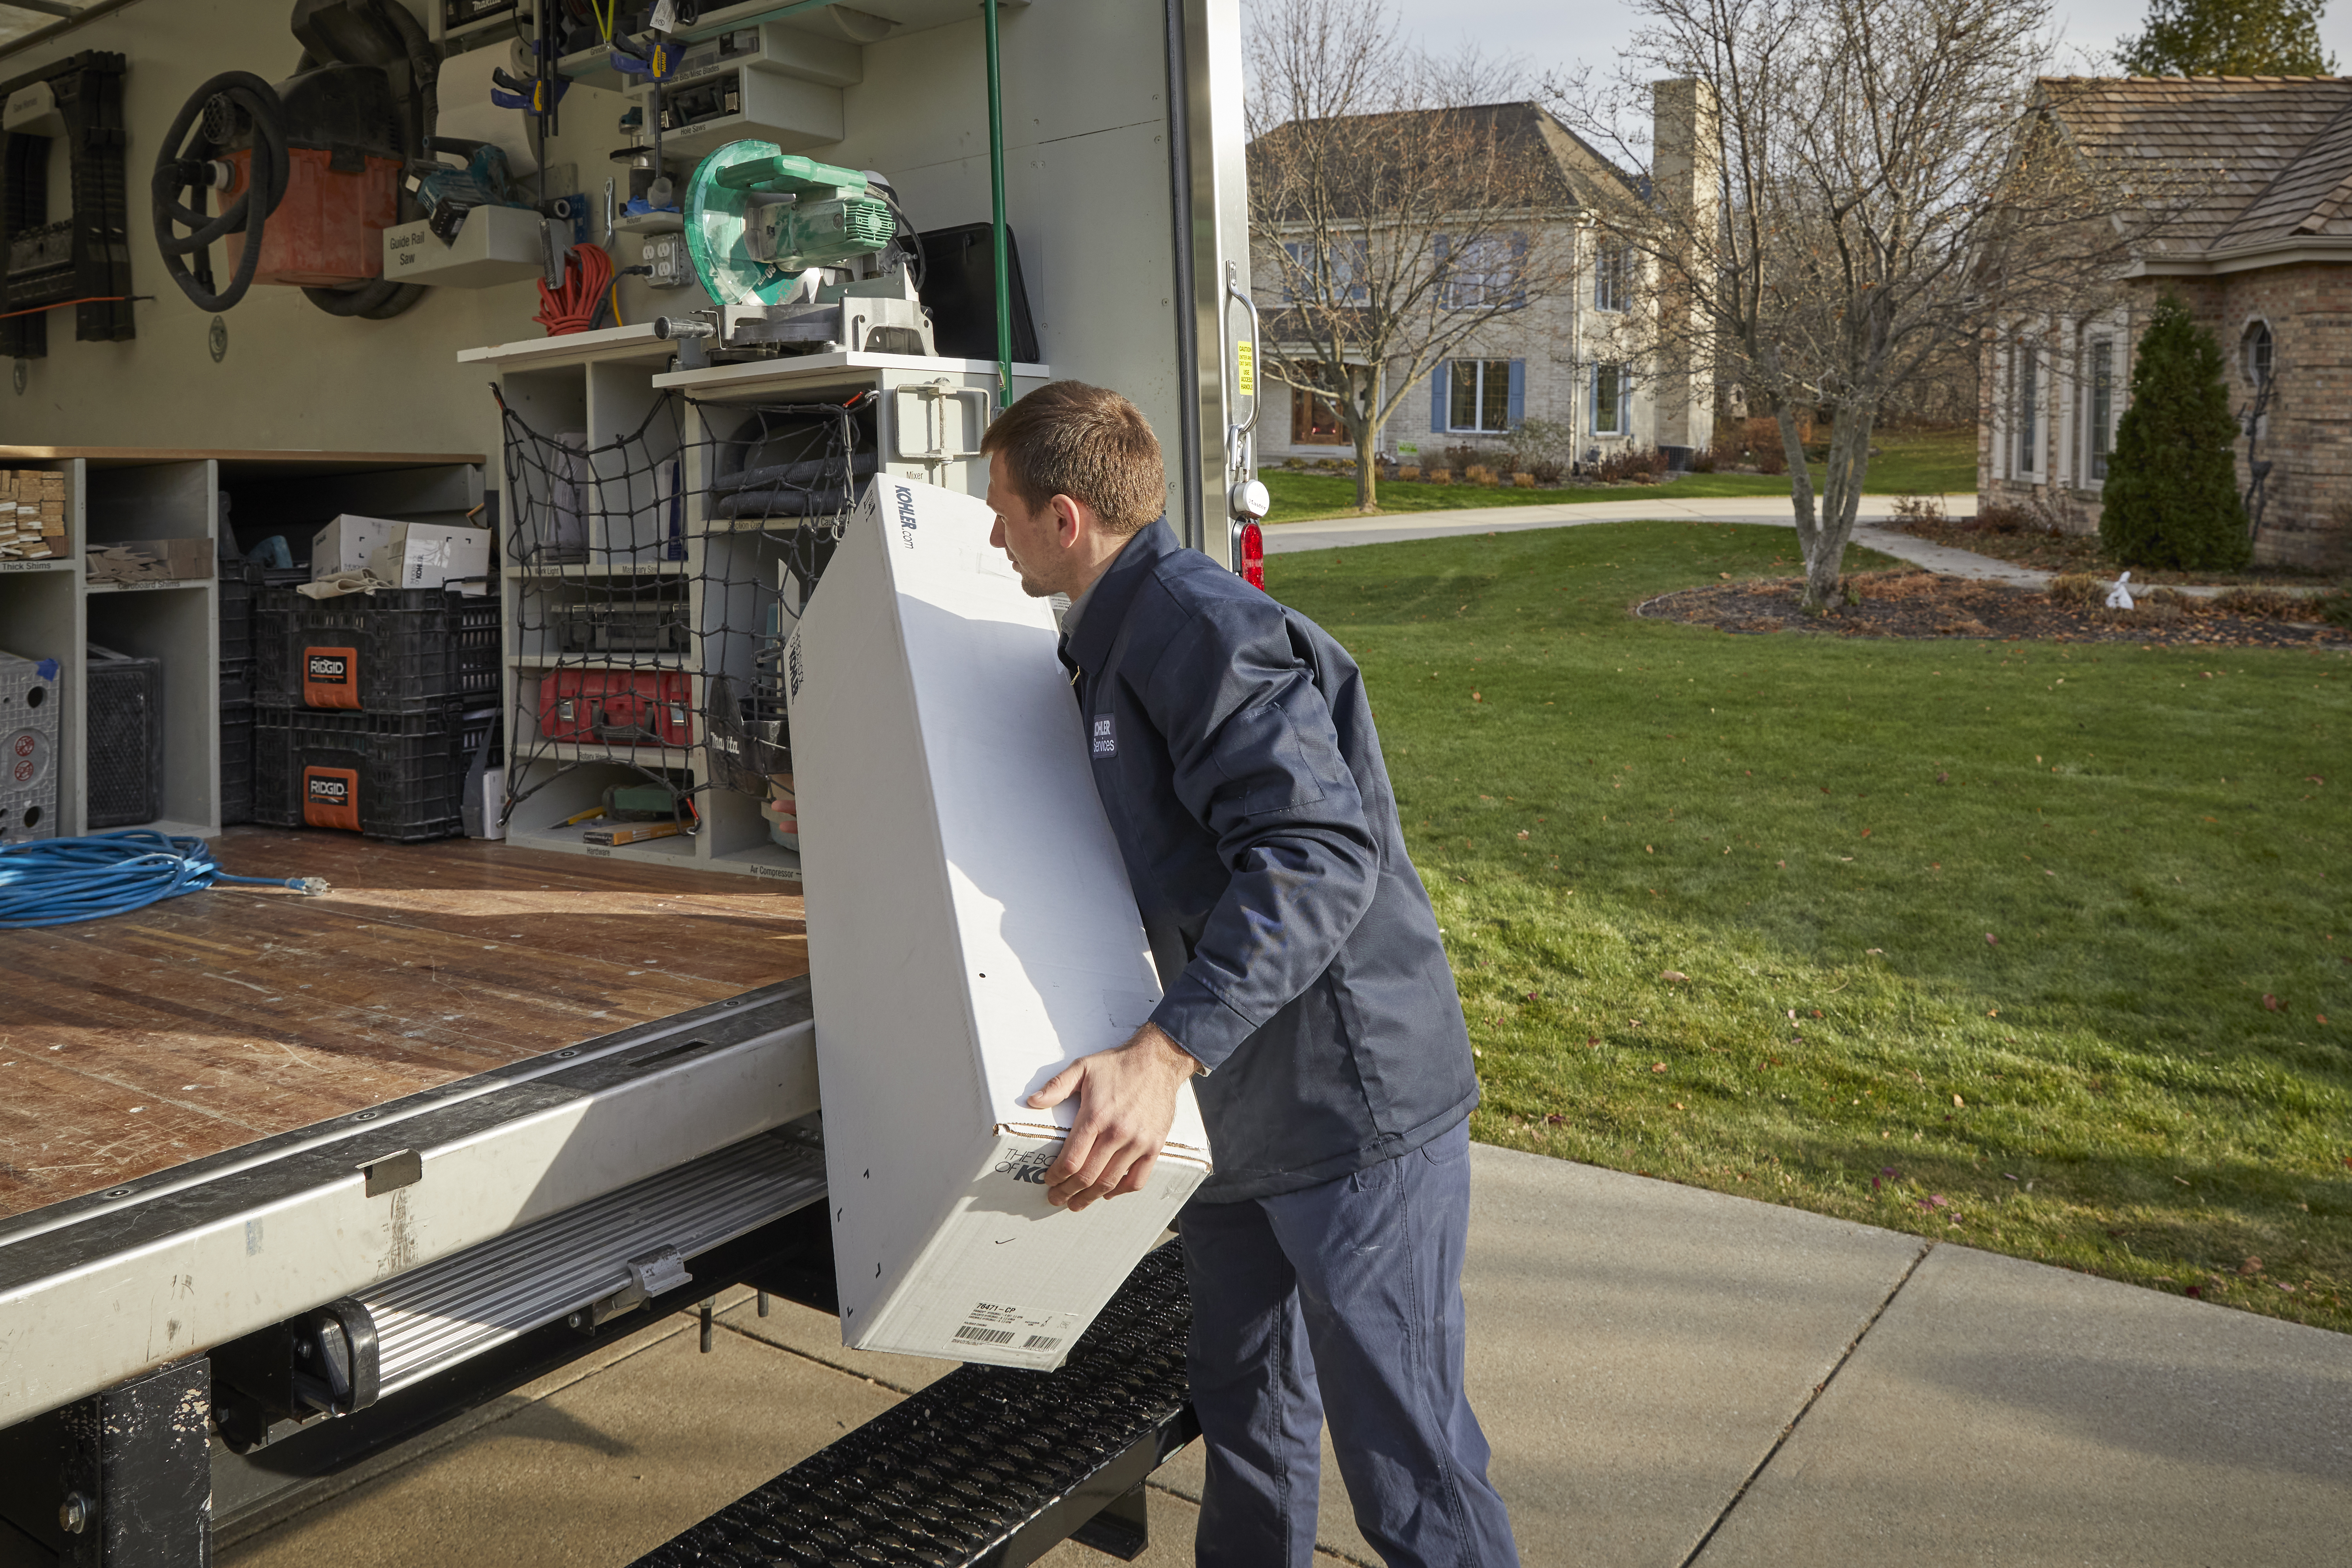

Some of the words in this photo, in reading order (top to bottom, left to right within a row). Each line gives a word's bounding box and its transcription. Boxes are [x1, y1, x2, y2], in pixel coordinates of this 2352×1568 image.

[680, 69, 701, 81] Bits/Misc
[703, 65, 719, 74] Blades
[681, 127, 692, 135] Hole
[692, 124, 706, 133] Saws
[626, 216, 641, 224] Router
[390, 235, 410, 250] Guide
[411, 231, 425, 245] Rail
[400, 253, 415, 266] Saw
[764, 264, 777, 278] 80
[906, 471, 923, 479] Mixer
[1249, 499, 1266, 510] Master
[728, 521, 749, 530] Sction
[623, 565, 646, 574] Masnary
[310, 660, 344, 674] RIDGID
[1094, 737, 1114, 752] Services
[310, 780, 345, 796] RIDGID
[587, 847, 610, 856] Hardware
[750, 865, 759, 874] Air
[759, 866, 794, 878] Compressor
[1005, 1148, 1035, 1163] THE
[1033, 1154, 1058, 1166] BO
[995, 1161, 1020, 1173] OF
